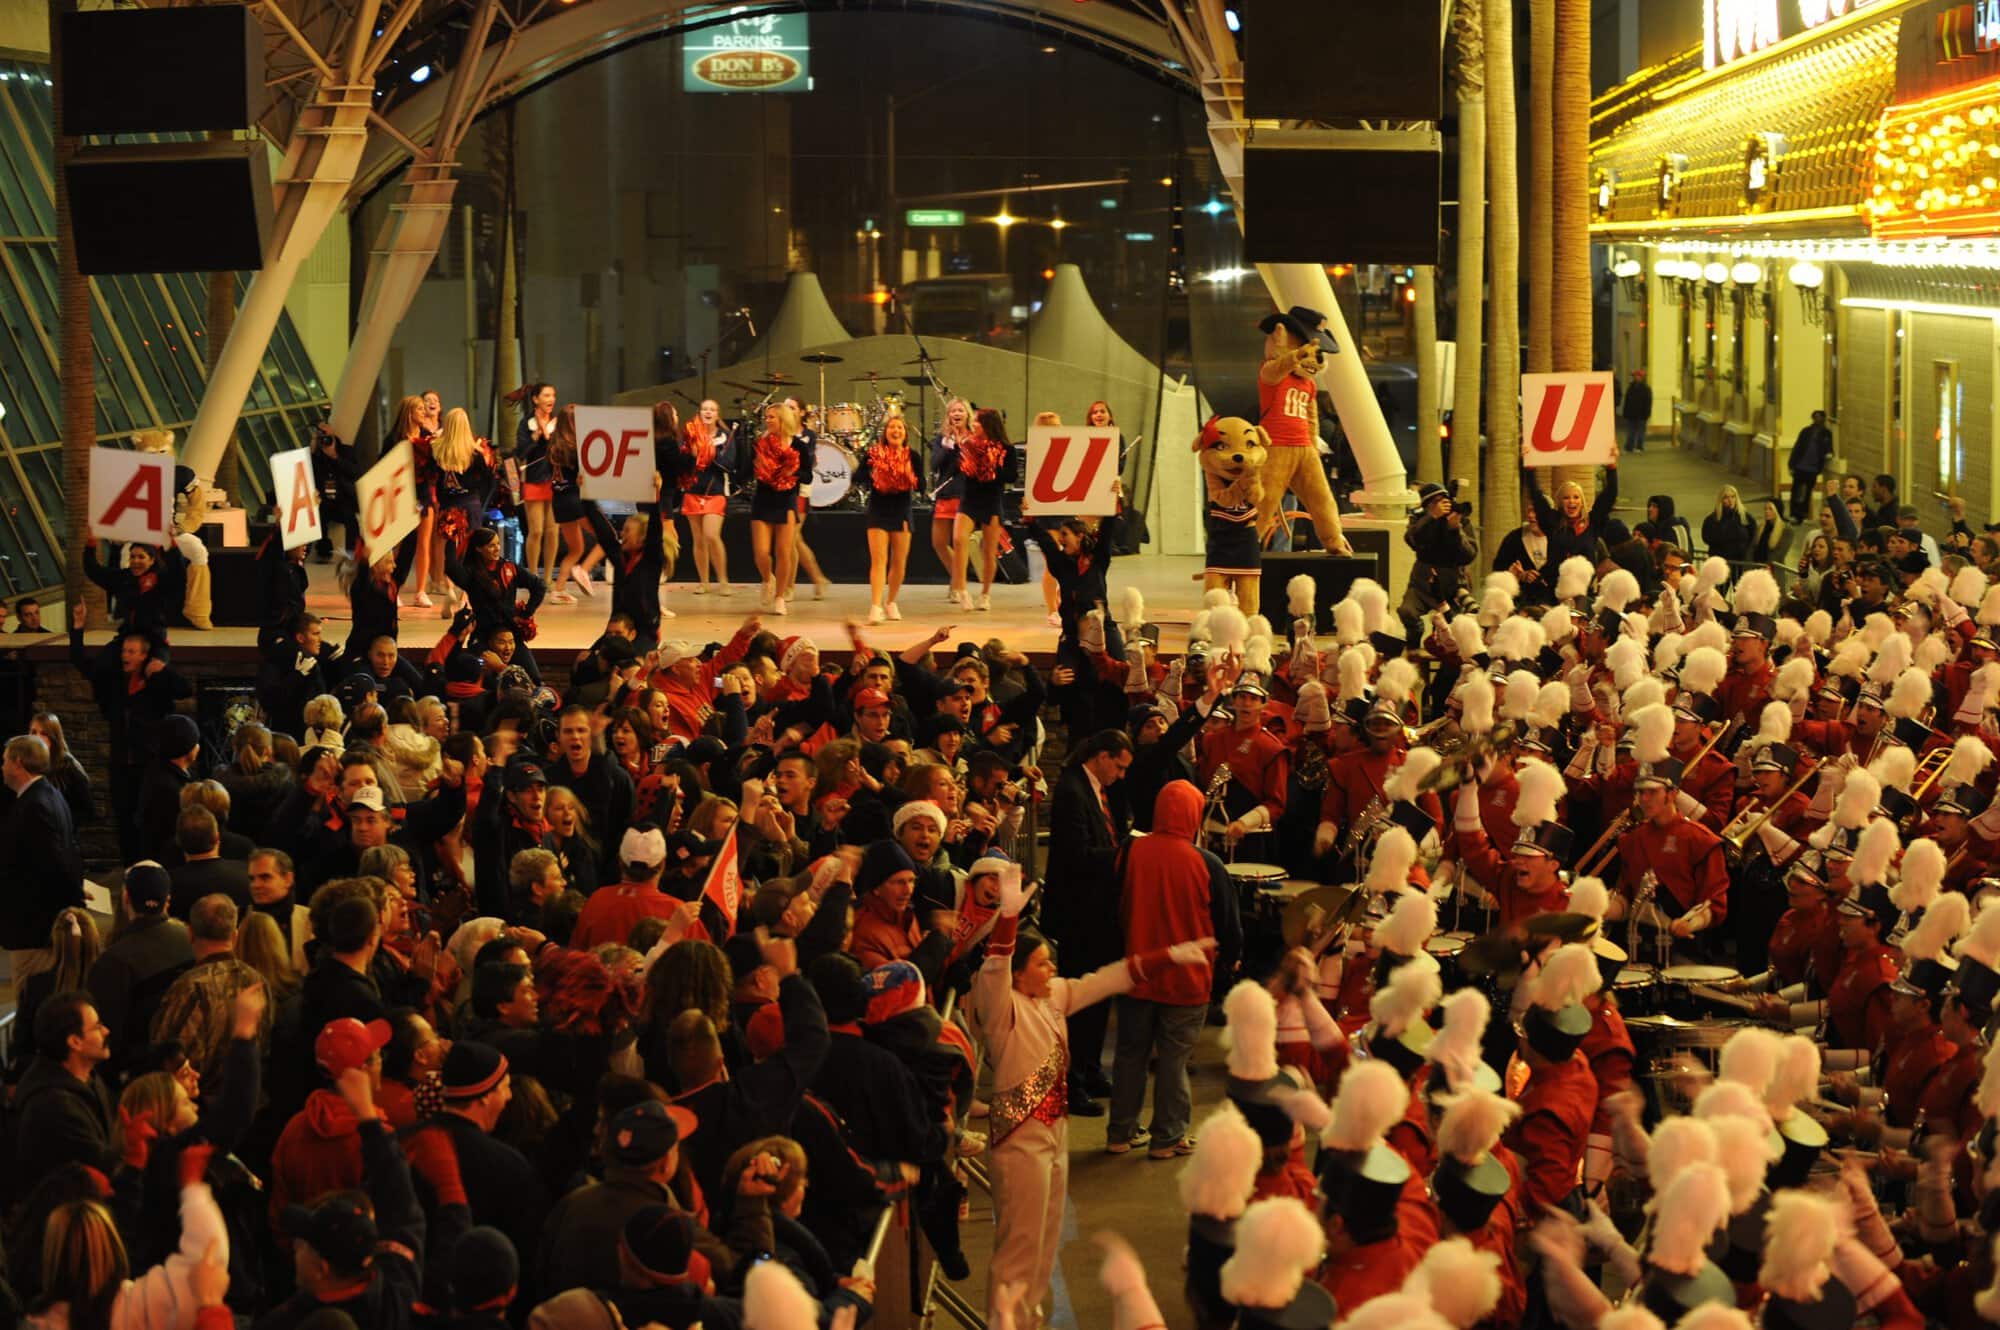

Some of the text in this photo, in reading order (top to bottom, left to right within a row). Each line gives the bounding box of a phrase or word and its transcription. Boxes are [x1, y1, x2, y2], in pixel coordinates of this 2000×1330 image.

[711, 59, 753, 72] DON
[713, 35, 783, 47] PARKING
[1531, 383, 1606, 453] U
[581, 429, 649, 478] OF
[1031, 437, 1110, 503] U
[98, 464, 162, 532] A
[287, 461, 316, 534] A
[366, 464, 410, 538] OF
